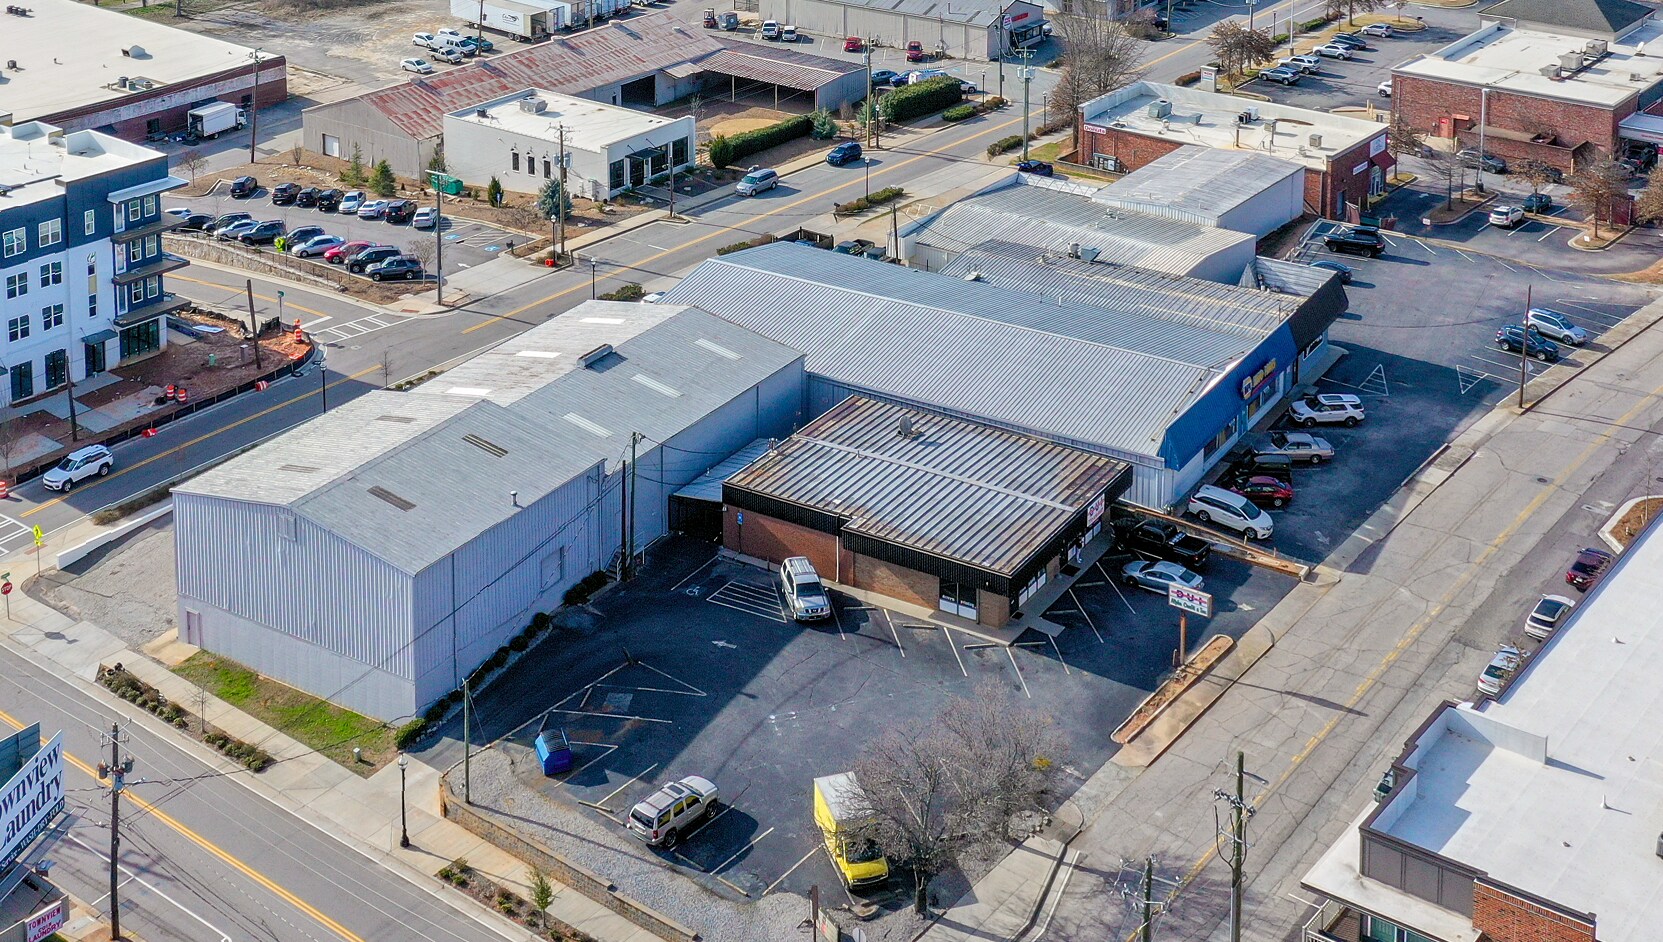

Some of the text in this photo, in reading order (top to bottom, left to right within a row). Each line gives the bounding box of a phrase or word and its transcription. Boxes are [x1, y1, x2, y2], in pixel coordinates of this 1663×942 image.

[1, 584, 12, 592] STOP
[0, 770, 62, 851] aundry
[28, 906, 61, 931] TOWNVIEW
[28, 919, 62, 942] LAUNDRY
